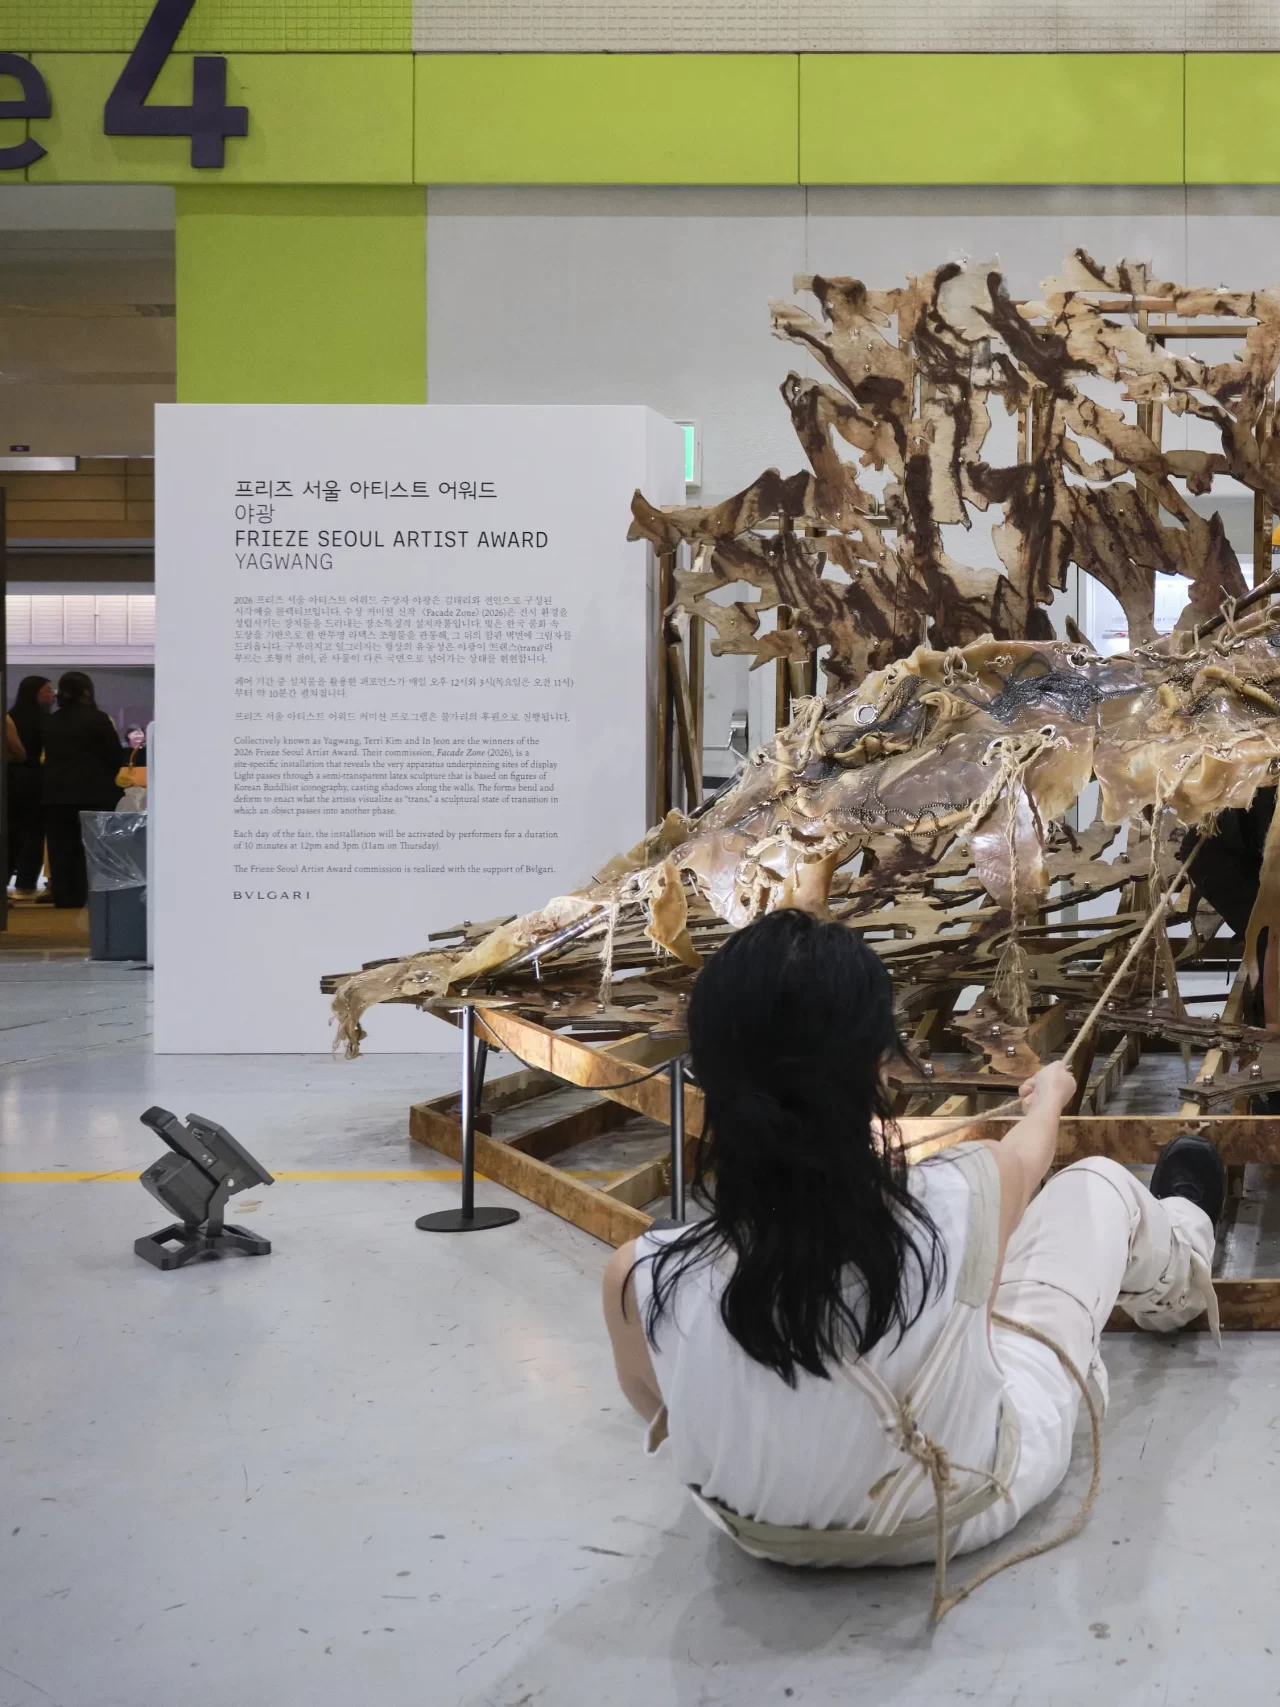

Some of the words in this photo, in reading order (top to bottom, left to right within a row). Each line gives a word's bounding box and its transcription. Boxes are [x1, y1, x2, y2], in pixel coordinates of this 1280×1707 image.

[104, 0, 248, 168] 4
[234, 479, 294, 500] 프리즈
[302, 479, 342, 503] 서울
[349, 480, 430, 500] 아티스트
[438, 480, 498, 501] 어워드
[234, 503, 276, 525] 야광
[235, 529, 309, 547] FRIEZE
[317, 530, 385, 548] SEOUL
[392, 530, 470, 548] ARTIST
[477, 531, 549, 549] AWARD
[235, 552, 333, 571] YAGWANG
[256, 595, 284, 604] 프리즈
[288, 595, 306, 605] 서울
[308, 595, 347, 605] 아티스트
[235, 711, 263, 721] 프리즈
[266, 711, 284, 722] 서울
[286, 711, 325, 721] 아티스트
[328, 711, 356, 721] 어워드
[359, 711, 387, 722] 커미션
[390, 711, 437, 722] 프로그램은
[441, 711, 477, 722] 불가리의
[480, 711, 520, 722] 후원으로
[523, 712, 570, 723] 진행됩니다.
[233, 736, 281, 747] Collectively
[283, 736, 311, 745] known
[323, 736, 362, 747] Yagwang,
[363, 736, 383, 745] Terri
[385, 736, 403, 745] Kim
[404, 736, 420, 745] and
[422, 736, 431, 745] In
[433, 736, 451, 745] Jeon
[467, 736, 481, 745] the
[482, 737, 515, 745] winners
[516, 736, 526, 745] of
[526, 736, 540, 745] the
[234, 748, 254, 756] 2026
[255, 748, 280, 756] Frieze
[281, 747, 304, 756] Seoul
[305, 748, 330, 756] Artist
[331, 748, 360, 757] Award.
[361, 748, 383, 757] Their
[384, 748, 435, 757] commission,
[436, 747, 465, 757] Facade
[465, 748, 486, 757] Zone
[515, 749, 523, 757] is
[233, 759, 279, 770] site-specific
[280, 759, 325, 768] installation
[325, 759, 342, 768] that
[343, 759, 371, 768] reveals
[372, 759, 386, 768] the
[386, 762, 405, 770] very
[406, 762, 445, 770] apparatus
[445, 759, 501, 771] underpinning
[501, 760, 519, 769] sites
[520, 759, 530, 768] of
[530, 759, 558, 771] display
[234, 771, 254, 782] Light
[255, 773, 281, 782] passes
[282, 771, 314, 782] through
[322, 773, 388, 782] semi-transparent
[389, 771, 409, 780] latex
[409, 771, 446, 782] sculpture
[447, 771, 464, 780] that
[465, 771, 473, 780] is
[473, 771, 497, 780] based
[510, 771, 537, 783] figures
[538, 771, 548, 780] of
[234, 783, 262, 792] Korean
[263, 782, 299, 792] Buddhist
[300, 782, 350, 794] iconography,
[350, 783, 380, 794] casting
[380, 783, 414, 792] shadows
[415, 782, 438, 794] along
[438, 782, 452, 792] the
[452, 782, 476, 792] walls.
[477, 783, 492, 792] The
[493, 782, 517, 792] forms
[518, 783, 538, 792] bend
[539, 783, 555, 792] and
[233, 794, 262, 803] deform
[296, 794, 315, 803] what
[317, 794, 330, 803] the
[331, 795, 356, 803] artists
[358, 794, 393, 803] visualize
[440, 794, 480, 806] sculptural
[501, 794, 511, 803] of
[511, 795, 549, 804] transition
[550, 795, 559, 803] in
[233, 806, 257, 815] which
[270, 806, 295, 816] object
[295, 808, 321, 817] passes
[340, 806, 371, 815] another
[371, 805, 397, 817] phase.
[233, 829, 253, 838] Each
[255, 829, 270, 840] day
[272, 829, 281, 838] of
[282, 829, 296, 838] the
[297, 829, 314, 838] fair,
[315, 829, 329, 838] the
[330, 829, 376, 838] installation
[378, 829, 394, 838] will
[396, 829, 406, 838] be
[407, 829, 445, 838] activated
[446, 829, 456, 840] by
[458, 829, 502, 841] performers
[504, 829, 516, 838] for
[524, 829, 558, 839] duration
[233, 840, 243, 850] of
[244, 841, 254, 850] 10
[300, 841, 322, 852] 12pm
[324, 841, 340, 850] and
[342, 841, 360, 852] 3pm
[361, 841, 385, 851] (11am
[399, 840, 442, 852] Thursday).
[233, 864, 249, 873] The
[250, 864, 275, 873] Frieze
[276, 864, 299, 873] Seoul
[300, 864, 325, 873] Artist
[326, 864, 353, 873] Award
[353, 865, 402, 873] commission
[403, 864, 412, 873] is
[412, 864, 446, 873] realized
[447, 864, 466, 873] with
[467, 864, 481, 873] the
[482, 866, 513, 876] support
[515, 864, 525, 873] of
[525, 864, 556, 876] Bvlgari.
[233, 890, 310, 900] BVLGARI
